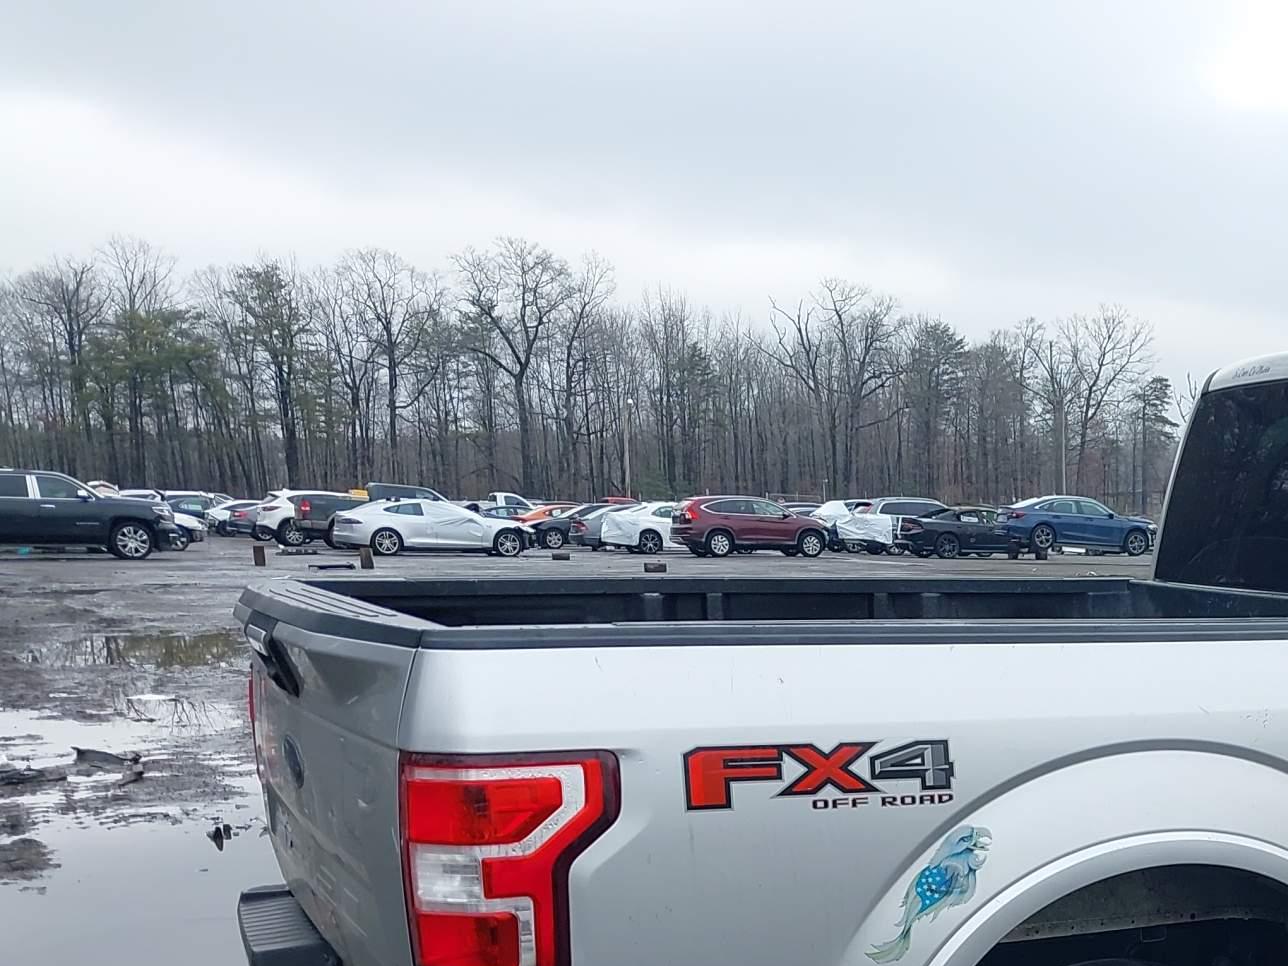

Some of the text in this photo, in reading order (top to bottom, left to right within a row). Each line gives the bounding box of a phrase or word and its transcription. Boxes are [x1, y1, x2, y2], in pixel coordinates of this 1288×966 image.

[683, 740, 954, 810] FX4
[812, 793, 954, 810] OFF ROAD
